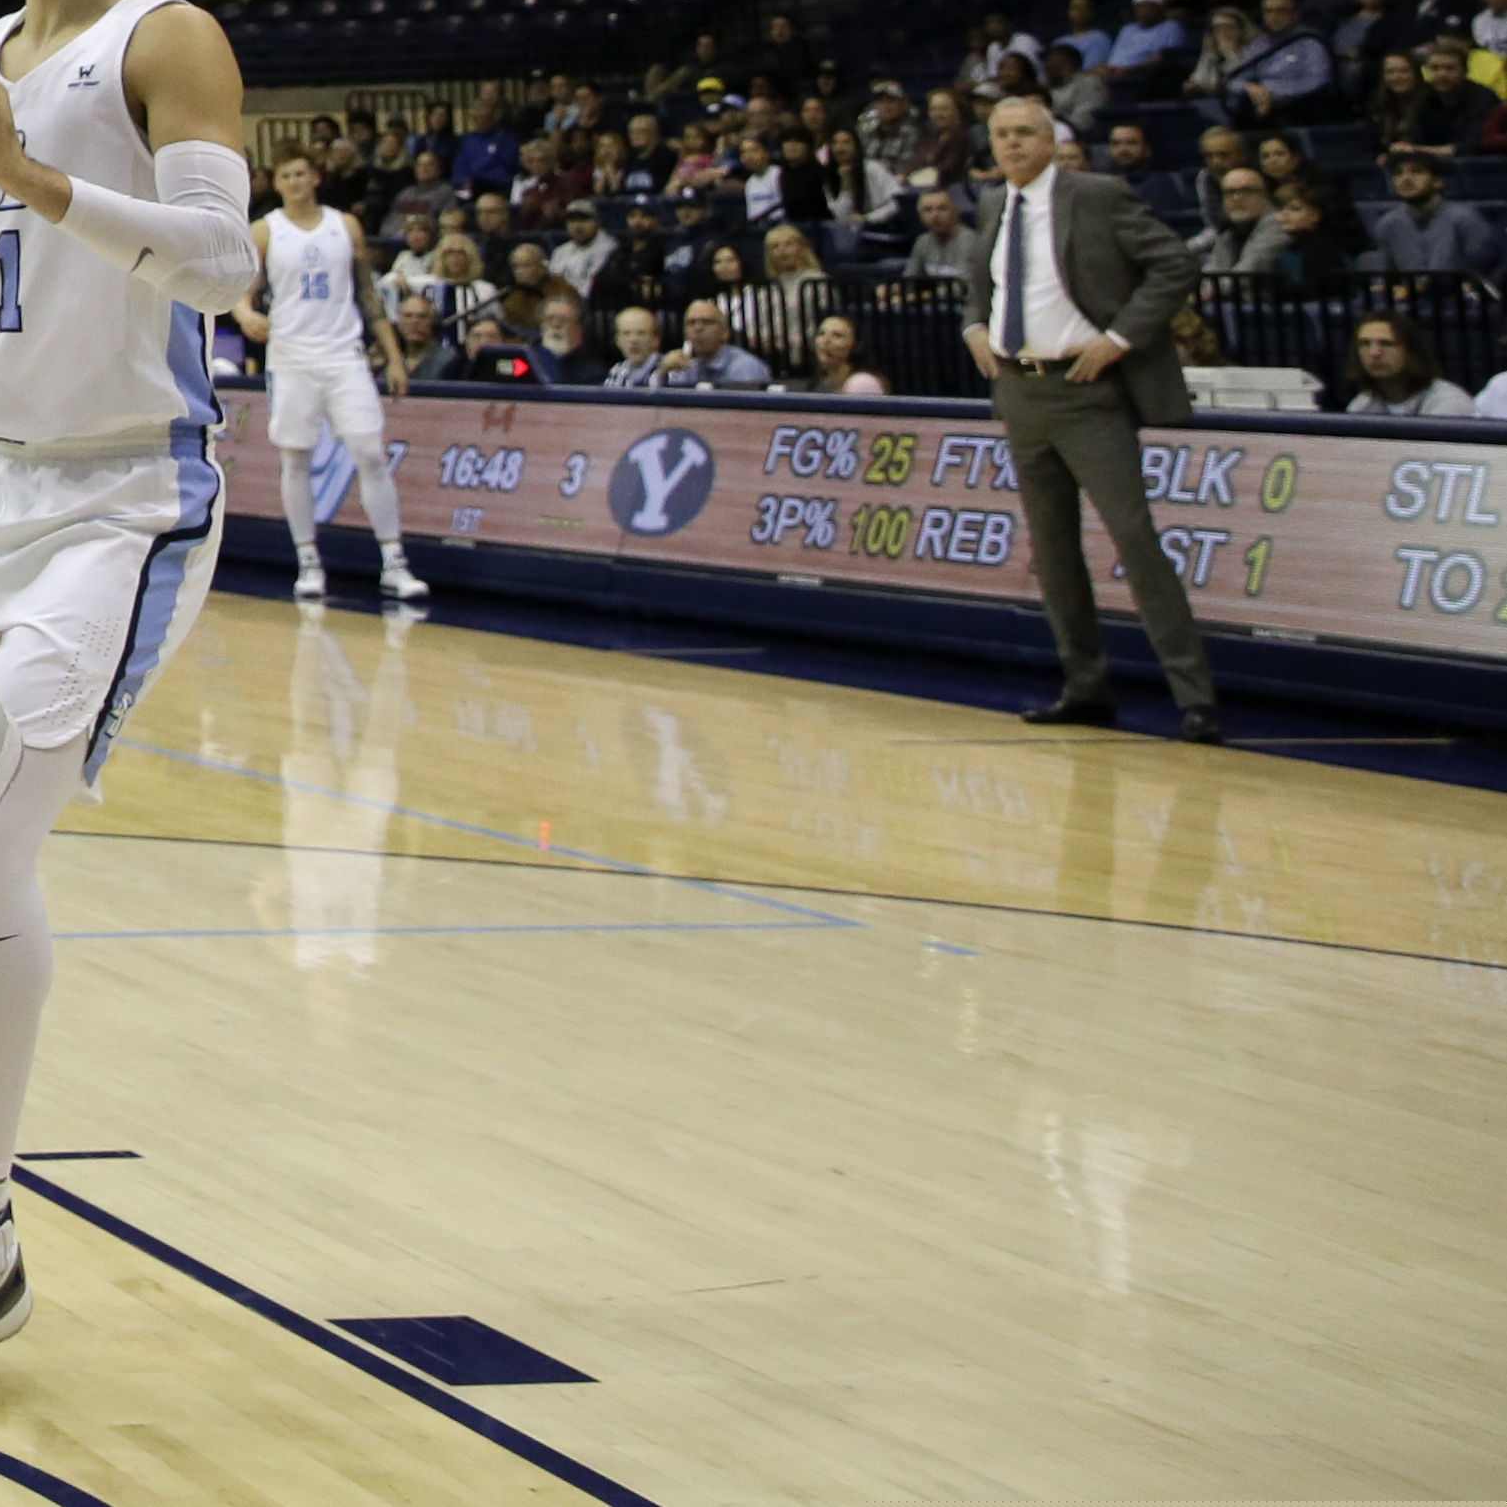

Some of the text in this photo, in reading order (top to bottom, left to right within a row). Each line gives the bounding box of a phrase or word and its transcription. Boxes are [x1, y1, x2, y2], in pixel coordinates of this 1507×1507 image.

[301, 272, 328, 300] 15
[439, 444, 527, 491] 16:48
[559, 450, 588, 497] 3
[763, 426, 859, 479] FG%
[865, 433, 918, 485] 25
[1140, 445, 1296, 512] BLK 0
[1385, 459, 1499, 525] STL
[751, 493, 1013, 566] 3P% 100 REB
[1113, 526, 1272, 595] ST 1
[1396, 547, 1486, 613] TO
